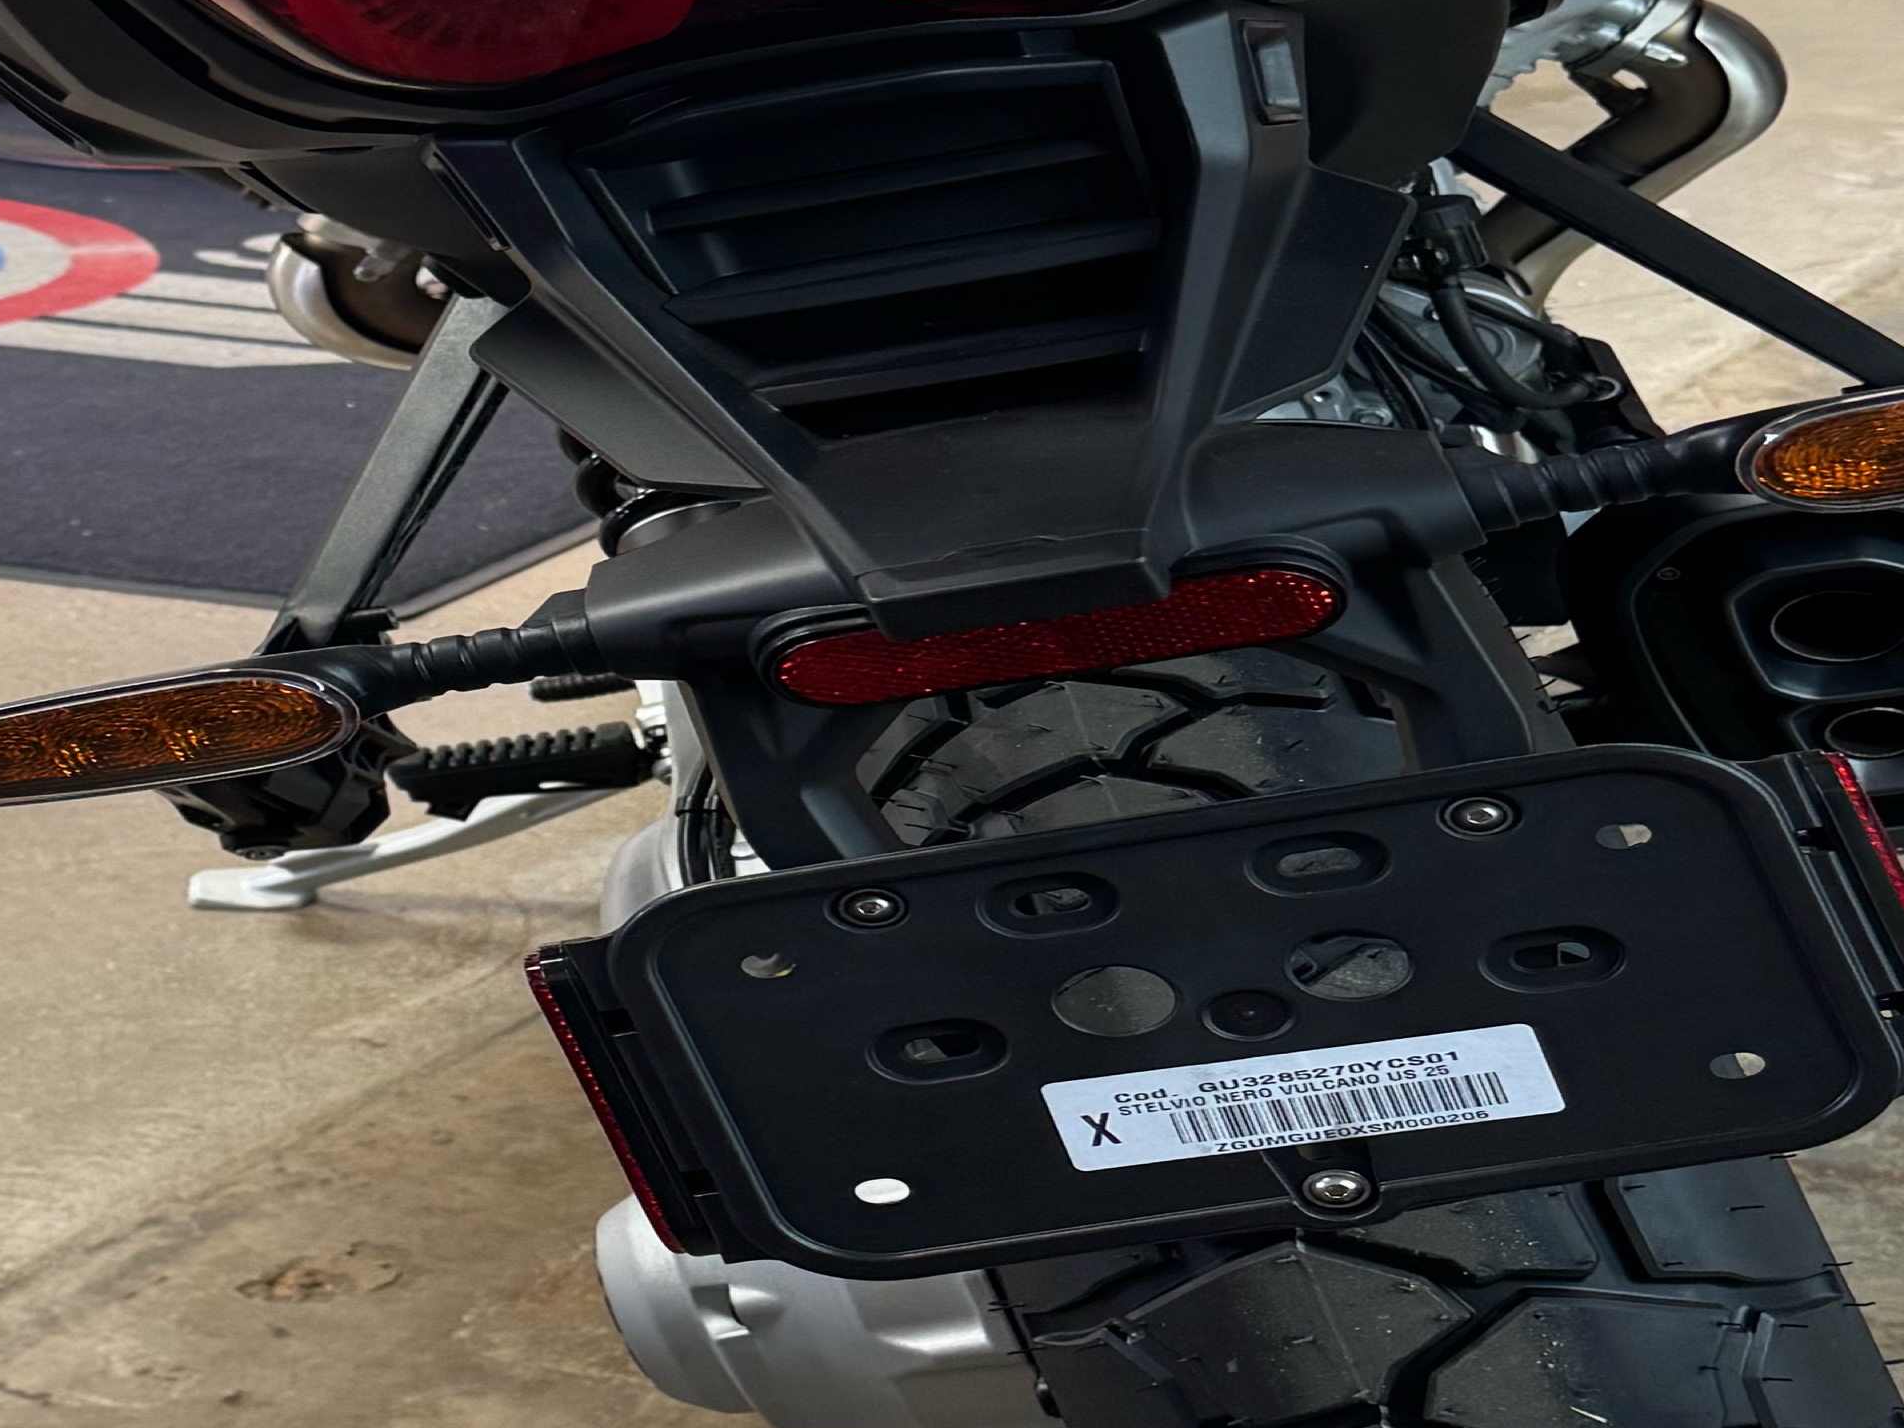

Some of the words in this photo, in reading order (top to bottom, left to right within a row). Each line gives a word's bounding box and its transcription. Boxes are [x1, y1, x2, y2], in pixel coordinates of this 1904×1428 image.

[1114, 1088, 1180, 1104] Cod.
[1199, 1051, 1460, 1093] GU3285270YCS01
[1118, 1096, 1206, 1116] STELVIO
[1214, 1088, 1274, 1104] NERO
[1279, 1074, 1381, 1095] VULCANO
[1388, 1070, 1417, 1082] US
[1423, 1064, 1450, 1077] 25
[1080, 1111, 1124, 1147] X
